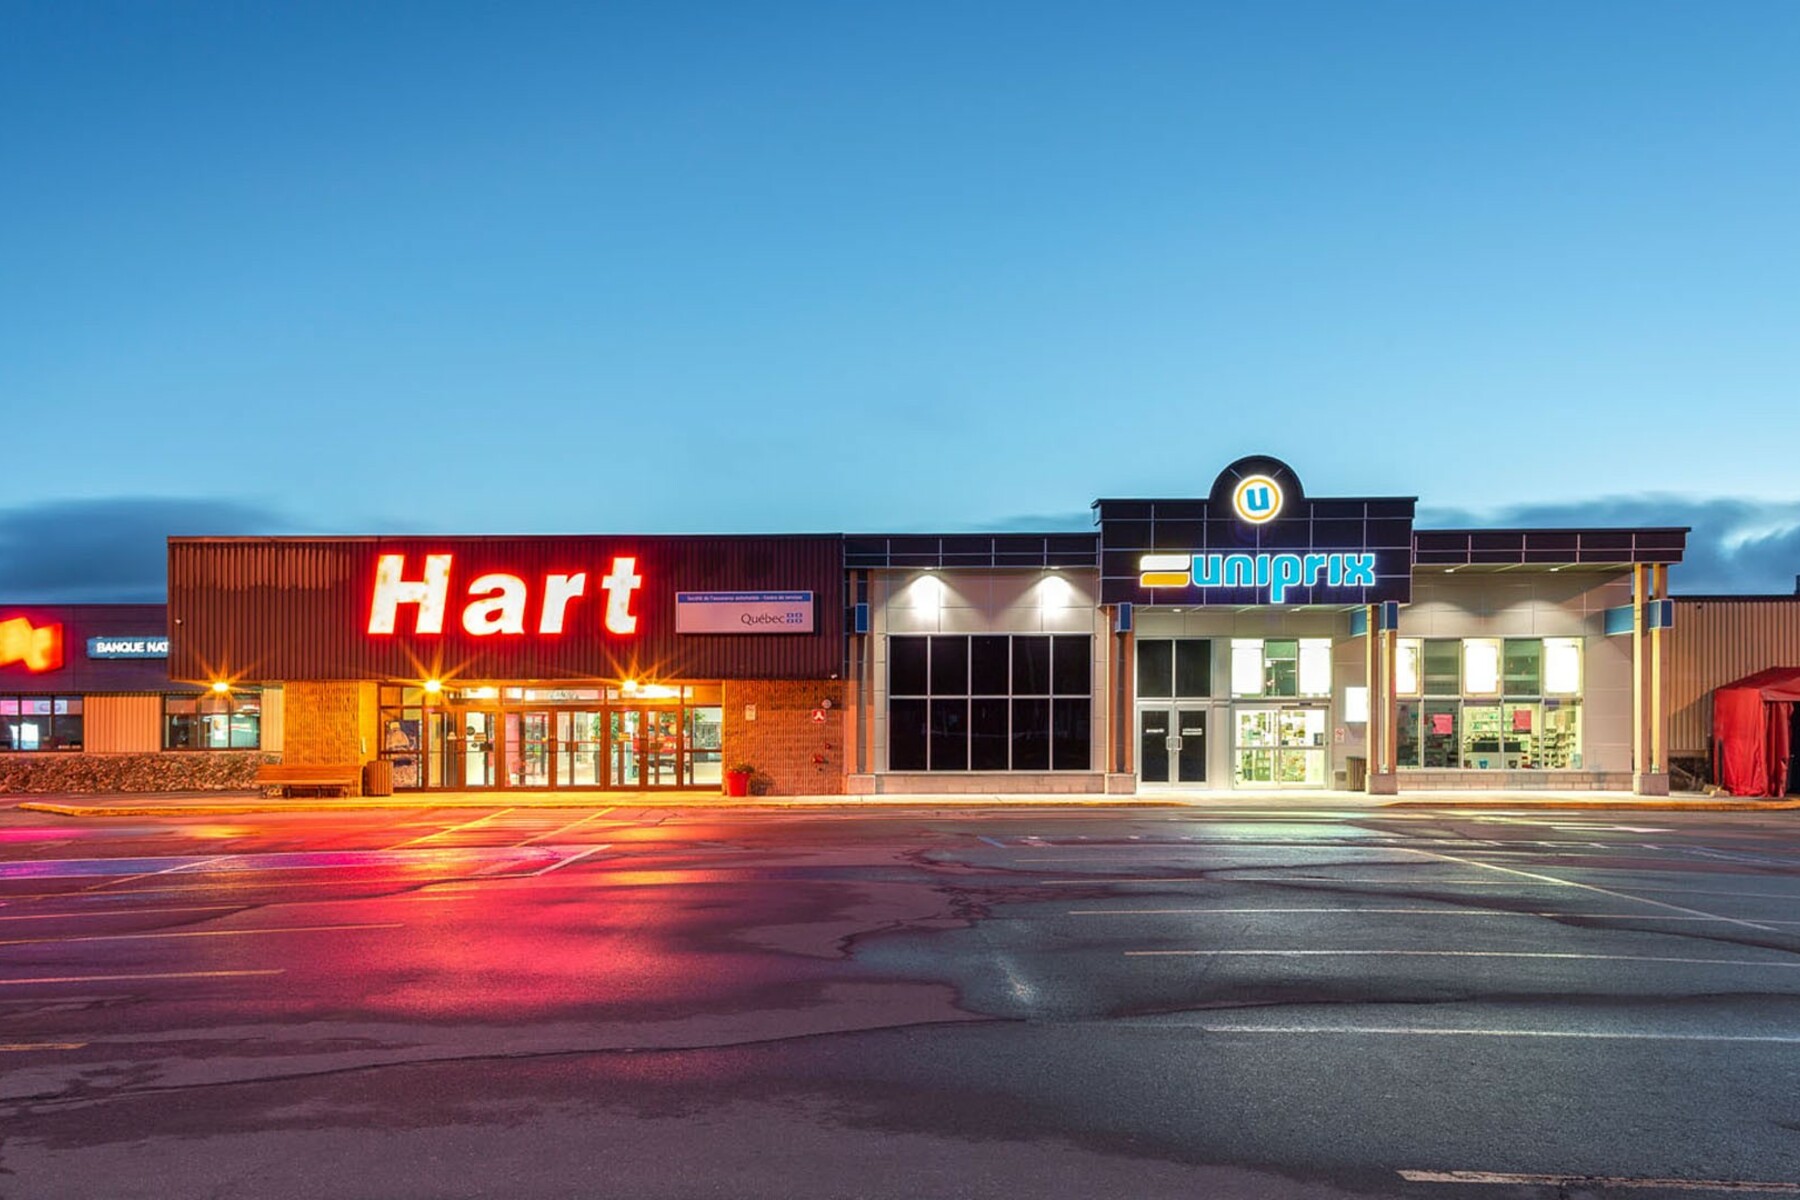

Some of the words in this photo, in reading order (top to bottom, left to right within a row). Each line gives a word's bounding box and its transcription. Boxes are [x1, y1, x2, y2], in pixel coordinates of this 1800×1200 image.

[1191, 553, 1376, 603] uniprix
[368, 553, 641, 635] Hart
[740, 613, 785, 625] Québec
[96, 641, 145, 653] BANQUE
